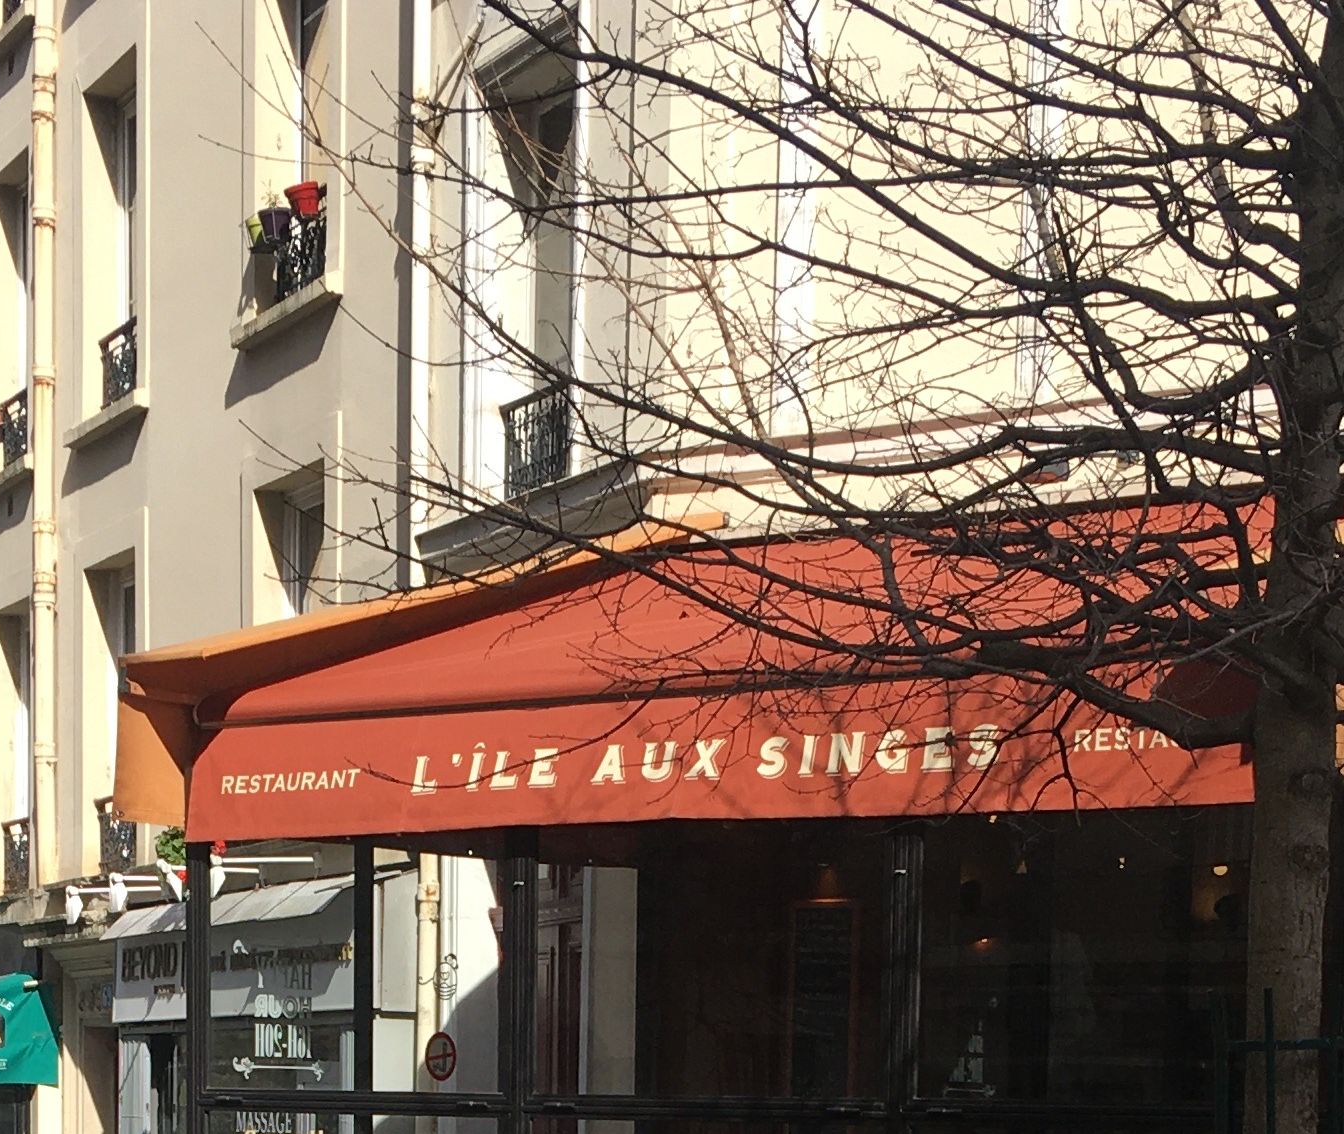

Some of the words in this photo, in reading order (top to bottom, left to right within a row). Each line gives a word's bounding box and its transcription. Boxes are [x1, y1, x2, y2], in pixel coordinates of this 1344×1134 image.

[221, 768, 360, 795] RESTAURANT
[410, 742, 559, 797] L'ÎLE
[590, 737, 730, 786] AUX
[756, 723, 1003, 779] SINGES
[122, 942, 177, 982] BEYOND
[236, 1111, 292, 1133] MASSAGE
